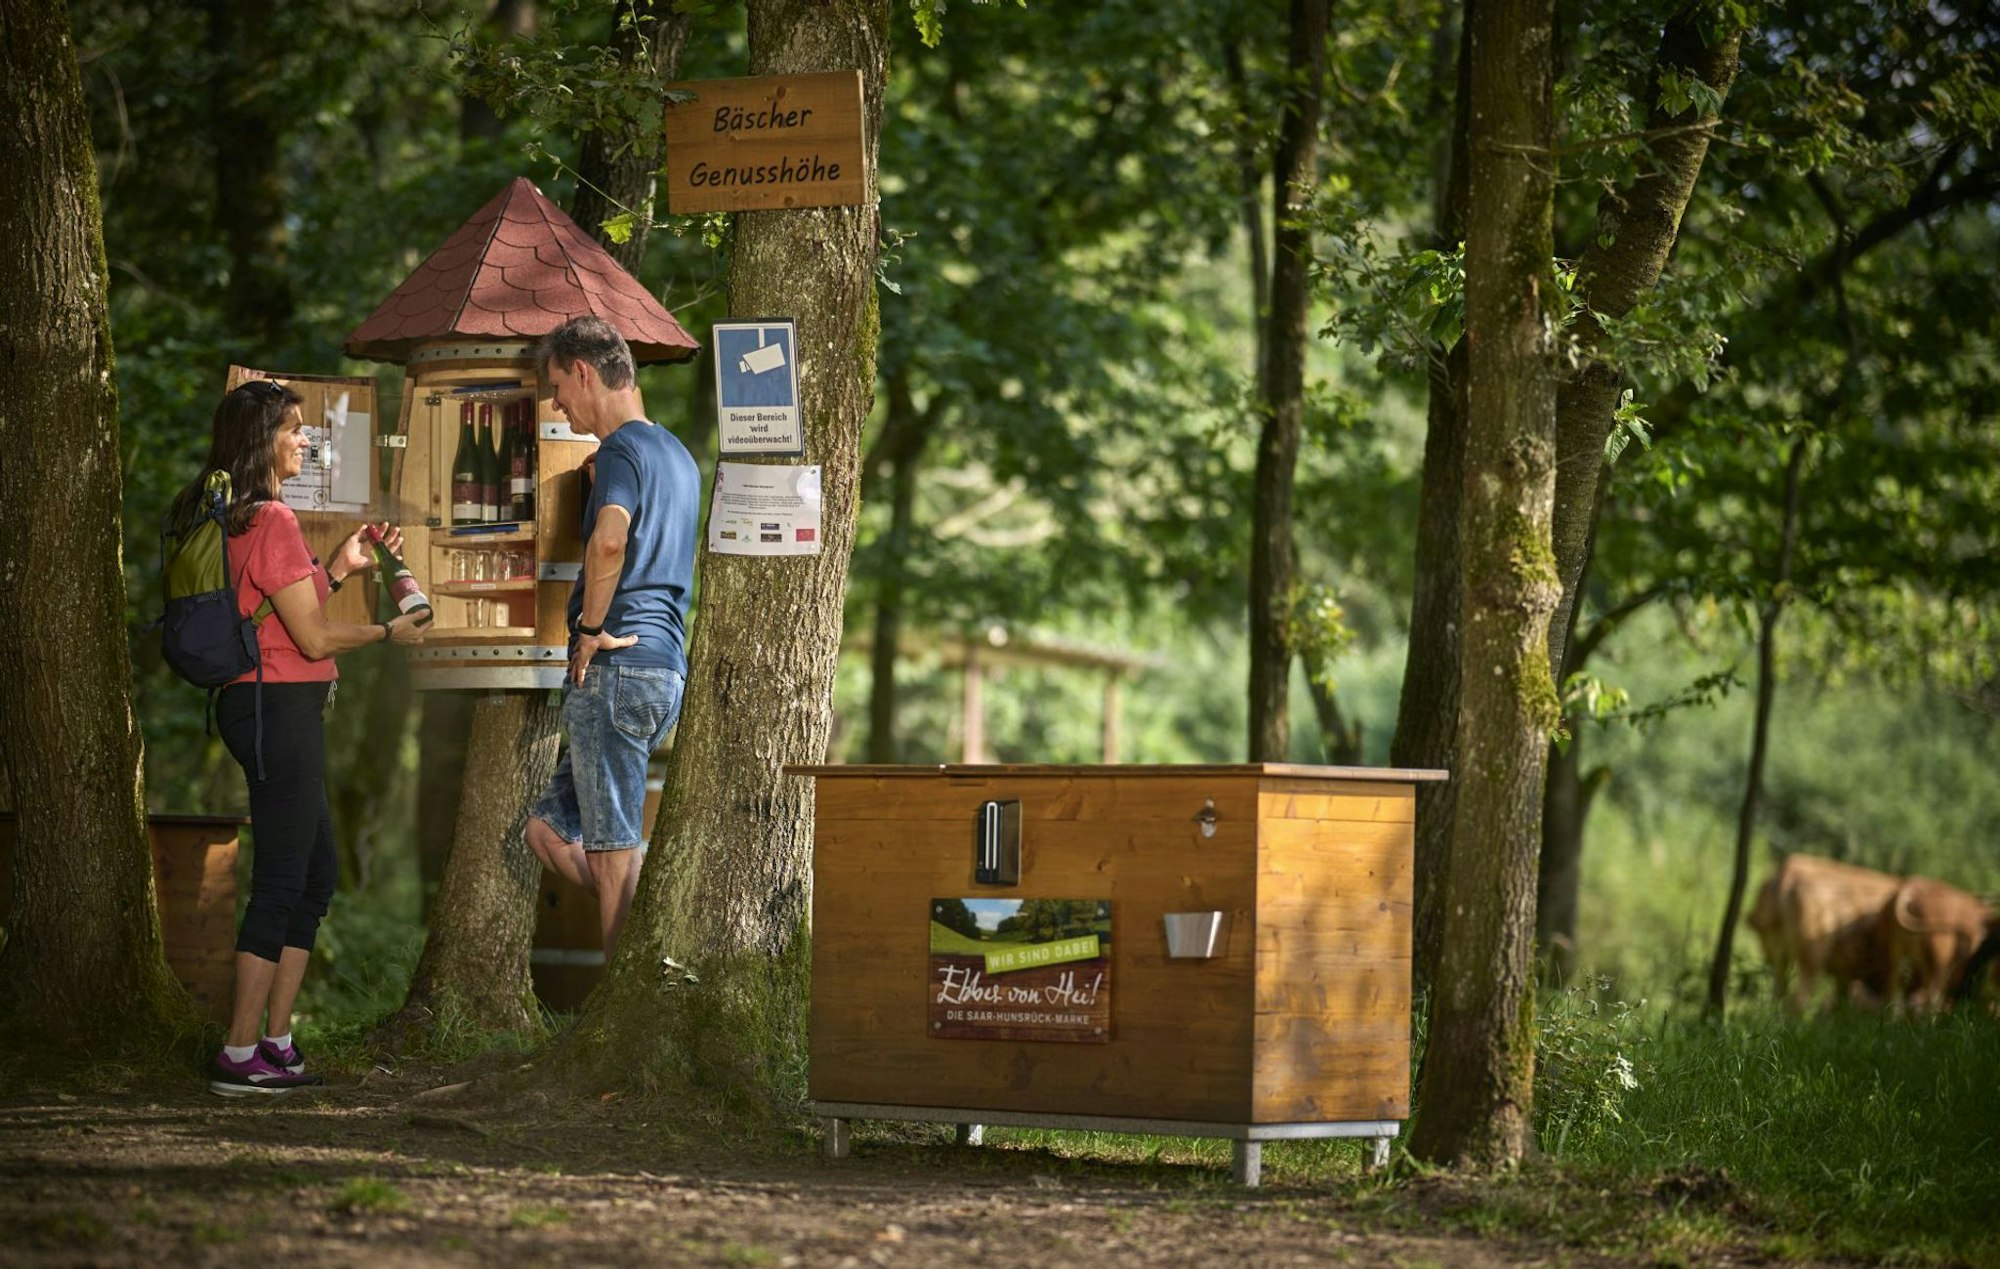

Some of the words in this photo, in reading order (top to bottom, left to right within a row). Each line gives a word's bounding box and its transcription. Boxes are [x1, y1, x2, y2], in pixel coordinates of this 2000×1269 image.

[713, 101, 813, 132] Bäscher
[689, 154, 841, 187] Genusshöhe
[730, 413, 755, 422] Dieser
[757, 412, 787, 422] Bereich
[750, 424, 768, 432] wird
[727, 435, 792, 444] videoüberwacht!
[989, 954, 1015, 968] WIR
[1019, 948, 1050, 964] SIND
[1055, 941, 1094, 959] DABEI
[936, 964, 1002, 1005] Ebbes
[1007, 986, 1042, 1004] von
[1045, 970, 1103, 1007] Hei!
[946, 1010, 963, 1020] DIE
[966, 1010, 1090, 1025] SAAR-HUNSRÜCK-MARKE
